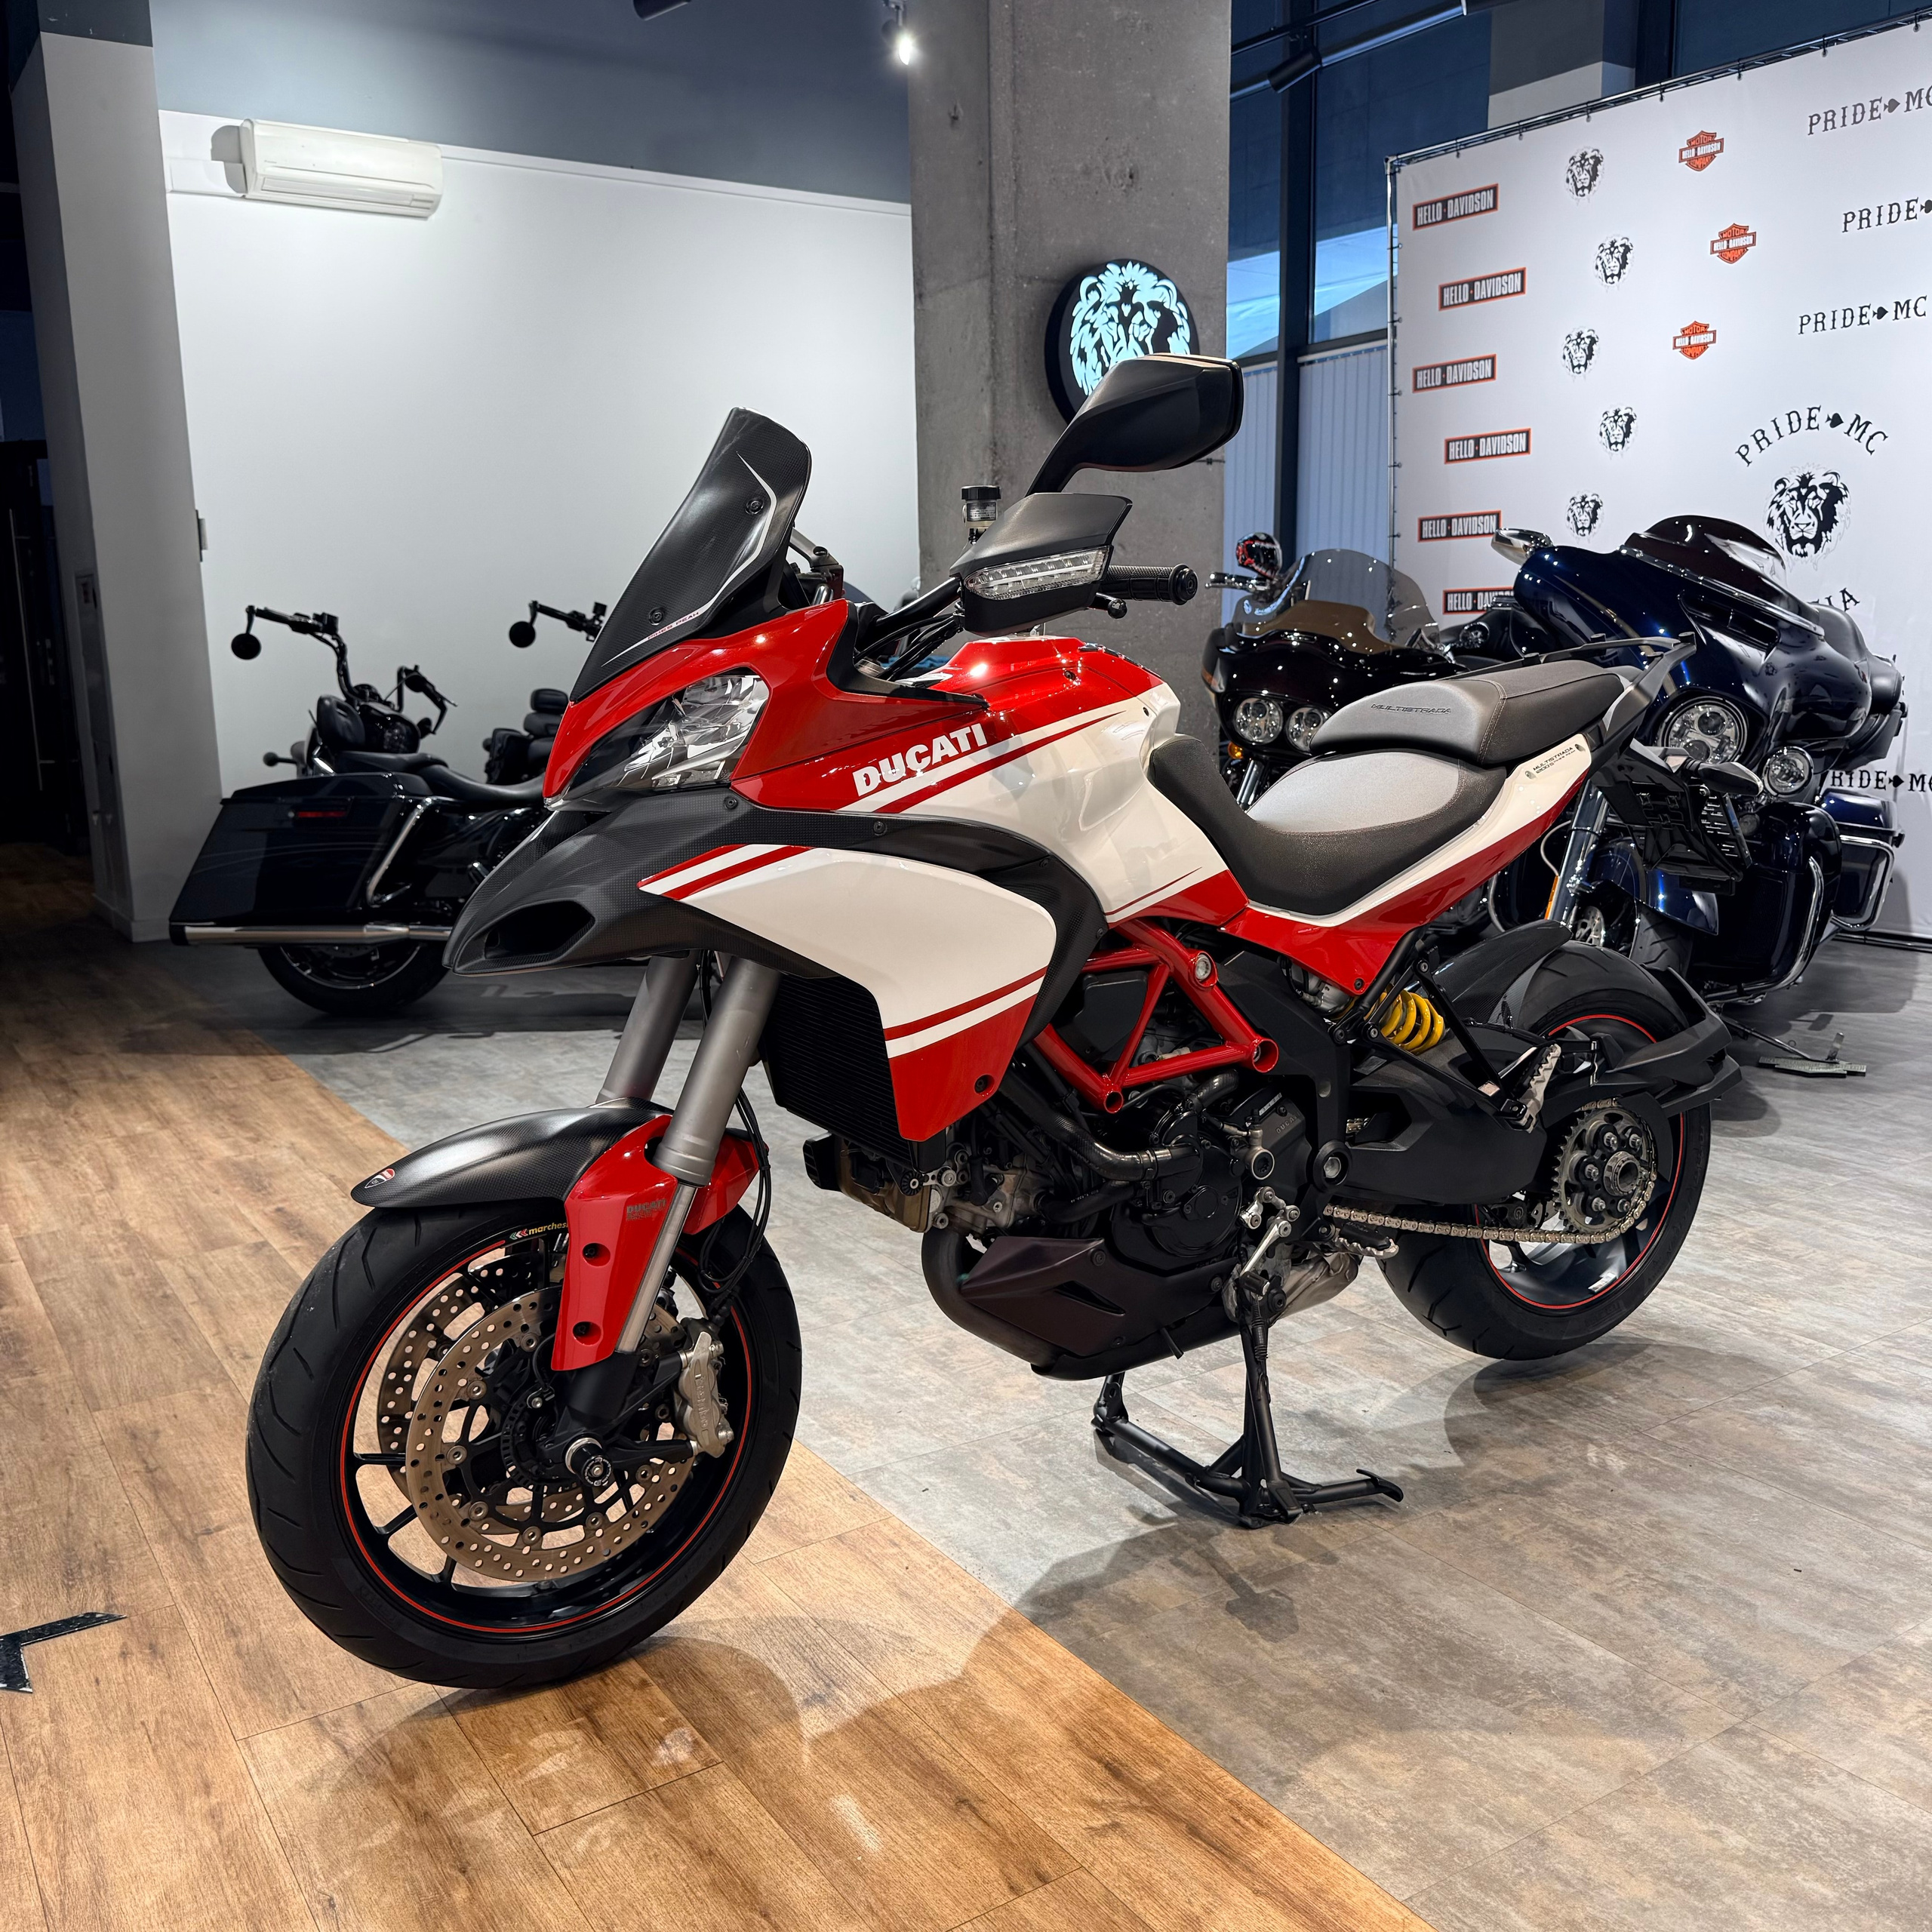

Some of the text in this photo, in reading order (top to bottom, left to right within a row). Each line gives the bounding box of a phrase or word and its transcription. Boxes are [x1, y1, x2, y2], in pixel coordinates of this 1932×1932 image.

[1807, 97, 1882, 135] PRIDE
[1690, 135, 1712, 146] MOTOR
[1417, 189, 1494, 226] HELLO DAVIDSON
[1842, 197, 1918, 232] PRIDE
[1722, 227, 1744, 238] MOTOR
[1443, 272, 1521, 306] HELLO DAVIDSON
[1798, 295, 1927, 335] PRIDE MC
[1684, 325, 1705, 334] MOTOR
[1417, 359, 1492, 389] HELLO DAVIDSON
[1449, 432, 1527, 460] HELLO DAVIDSON
[1735, 405, 1888, 467] PRIDE MC
[1422, 515, 1497, 539] HELLO DAVIDSON
[1447, 592, 1472, 611] HELLO
[1371, 704, 1451, 714] MULTISTRADA
[852, 723, 987, 797] DUCATI
[1533, 747, 1574, 771] MULTISTRADA
[1830, 770, 1887, 791] RIDE
